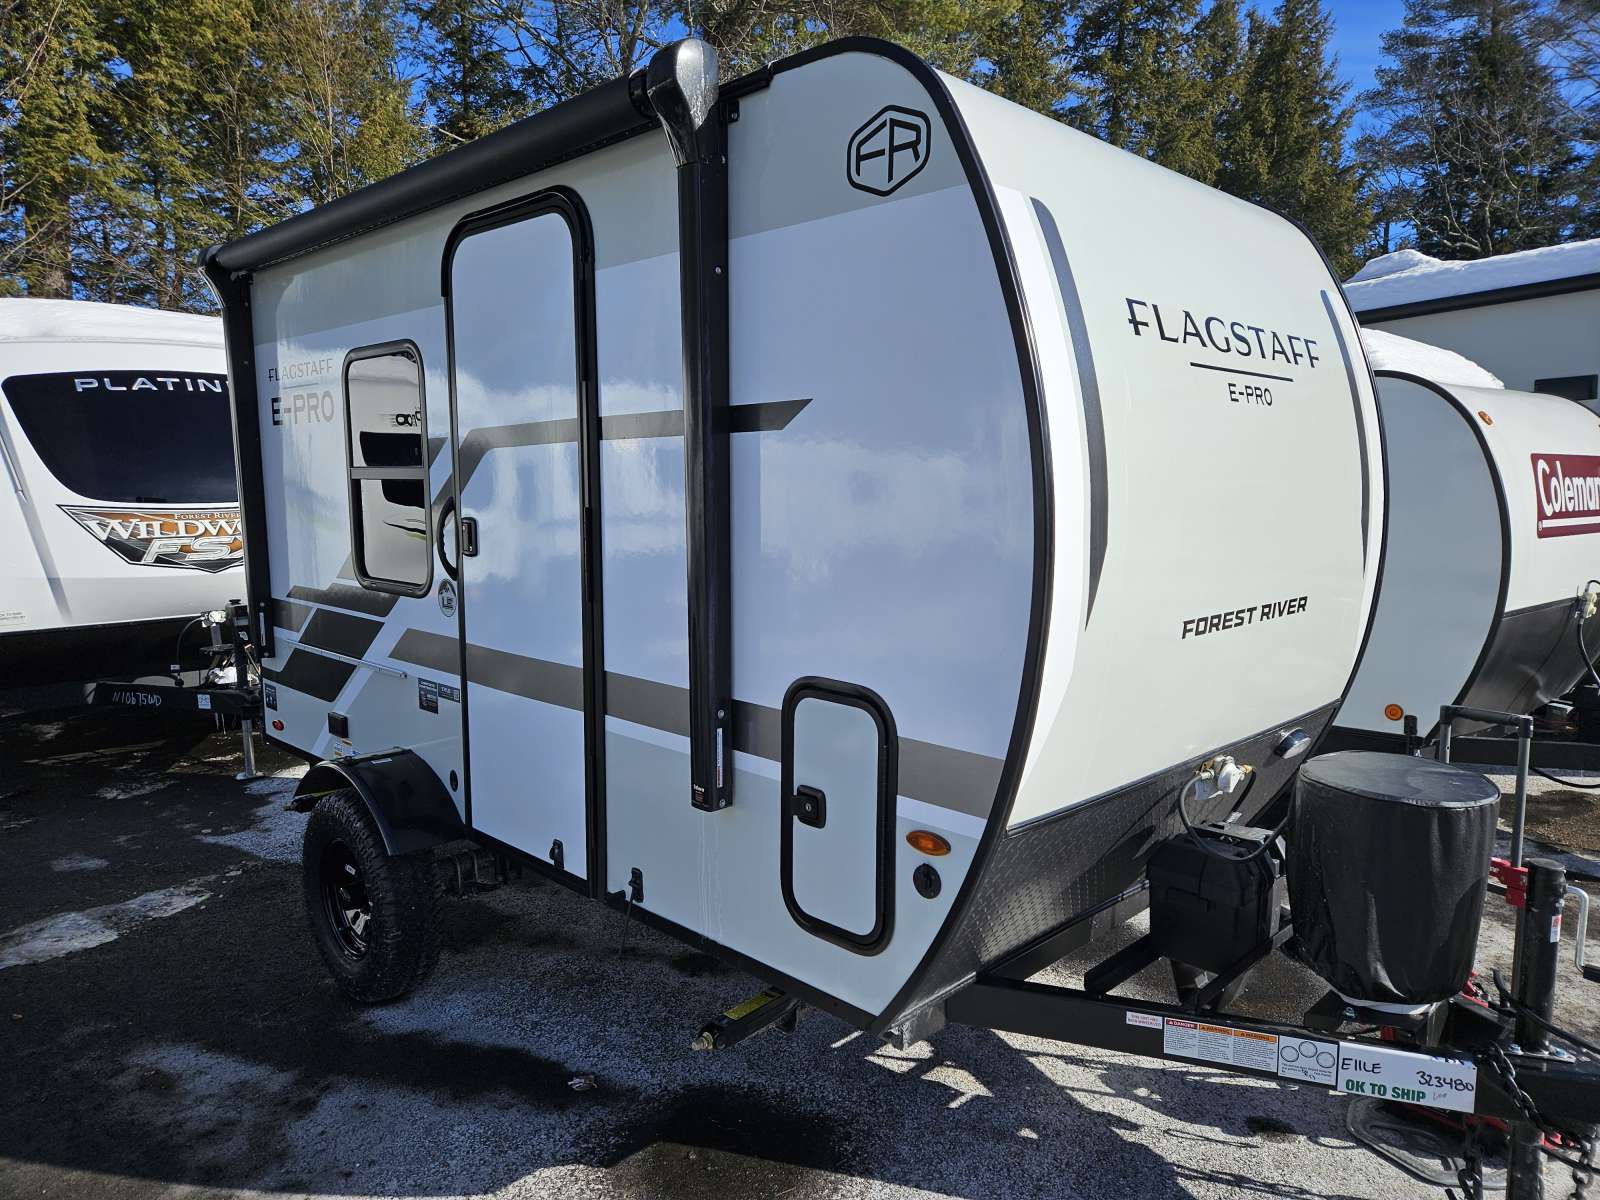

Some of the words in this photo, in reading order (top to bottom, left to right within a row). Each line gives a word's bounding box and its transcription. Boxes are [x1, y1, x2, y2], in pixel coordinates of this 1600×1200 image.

[1125, 297, 1320, 369] FLAGSTAFF
[268, 358, 334, 382] FLAGSTAFF
[74, 377, 229, 393] PLATIN
[1227, 382, 1273, 407] E-PRO
[271, 390, 335, 426] E-PRO
[1181, 606, 1258, 640] FOREST
[1260, 596, 1308, 622] RIVER
[1345, 1079, 1366, 1094] OK
[1369, 1082, 1387, 1097] TO
[1391, 1086, 1426, 1102] SHIP
[1416, 1070, 1475, 1092] 323480
